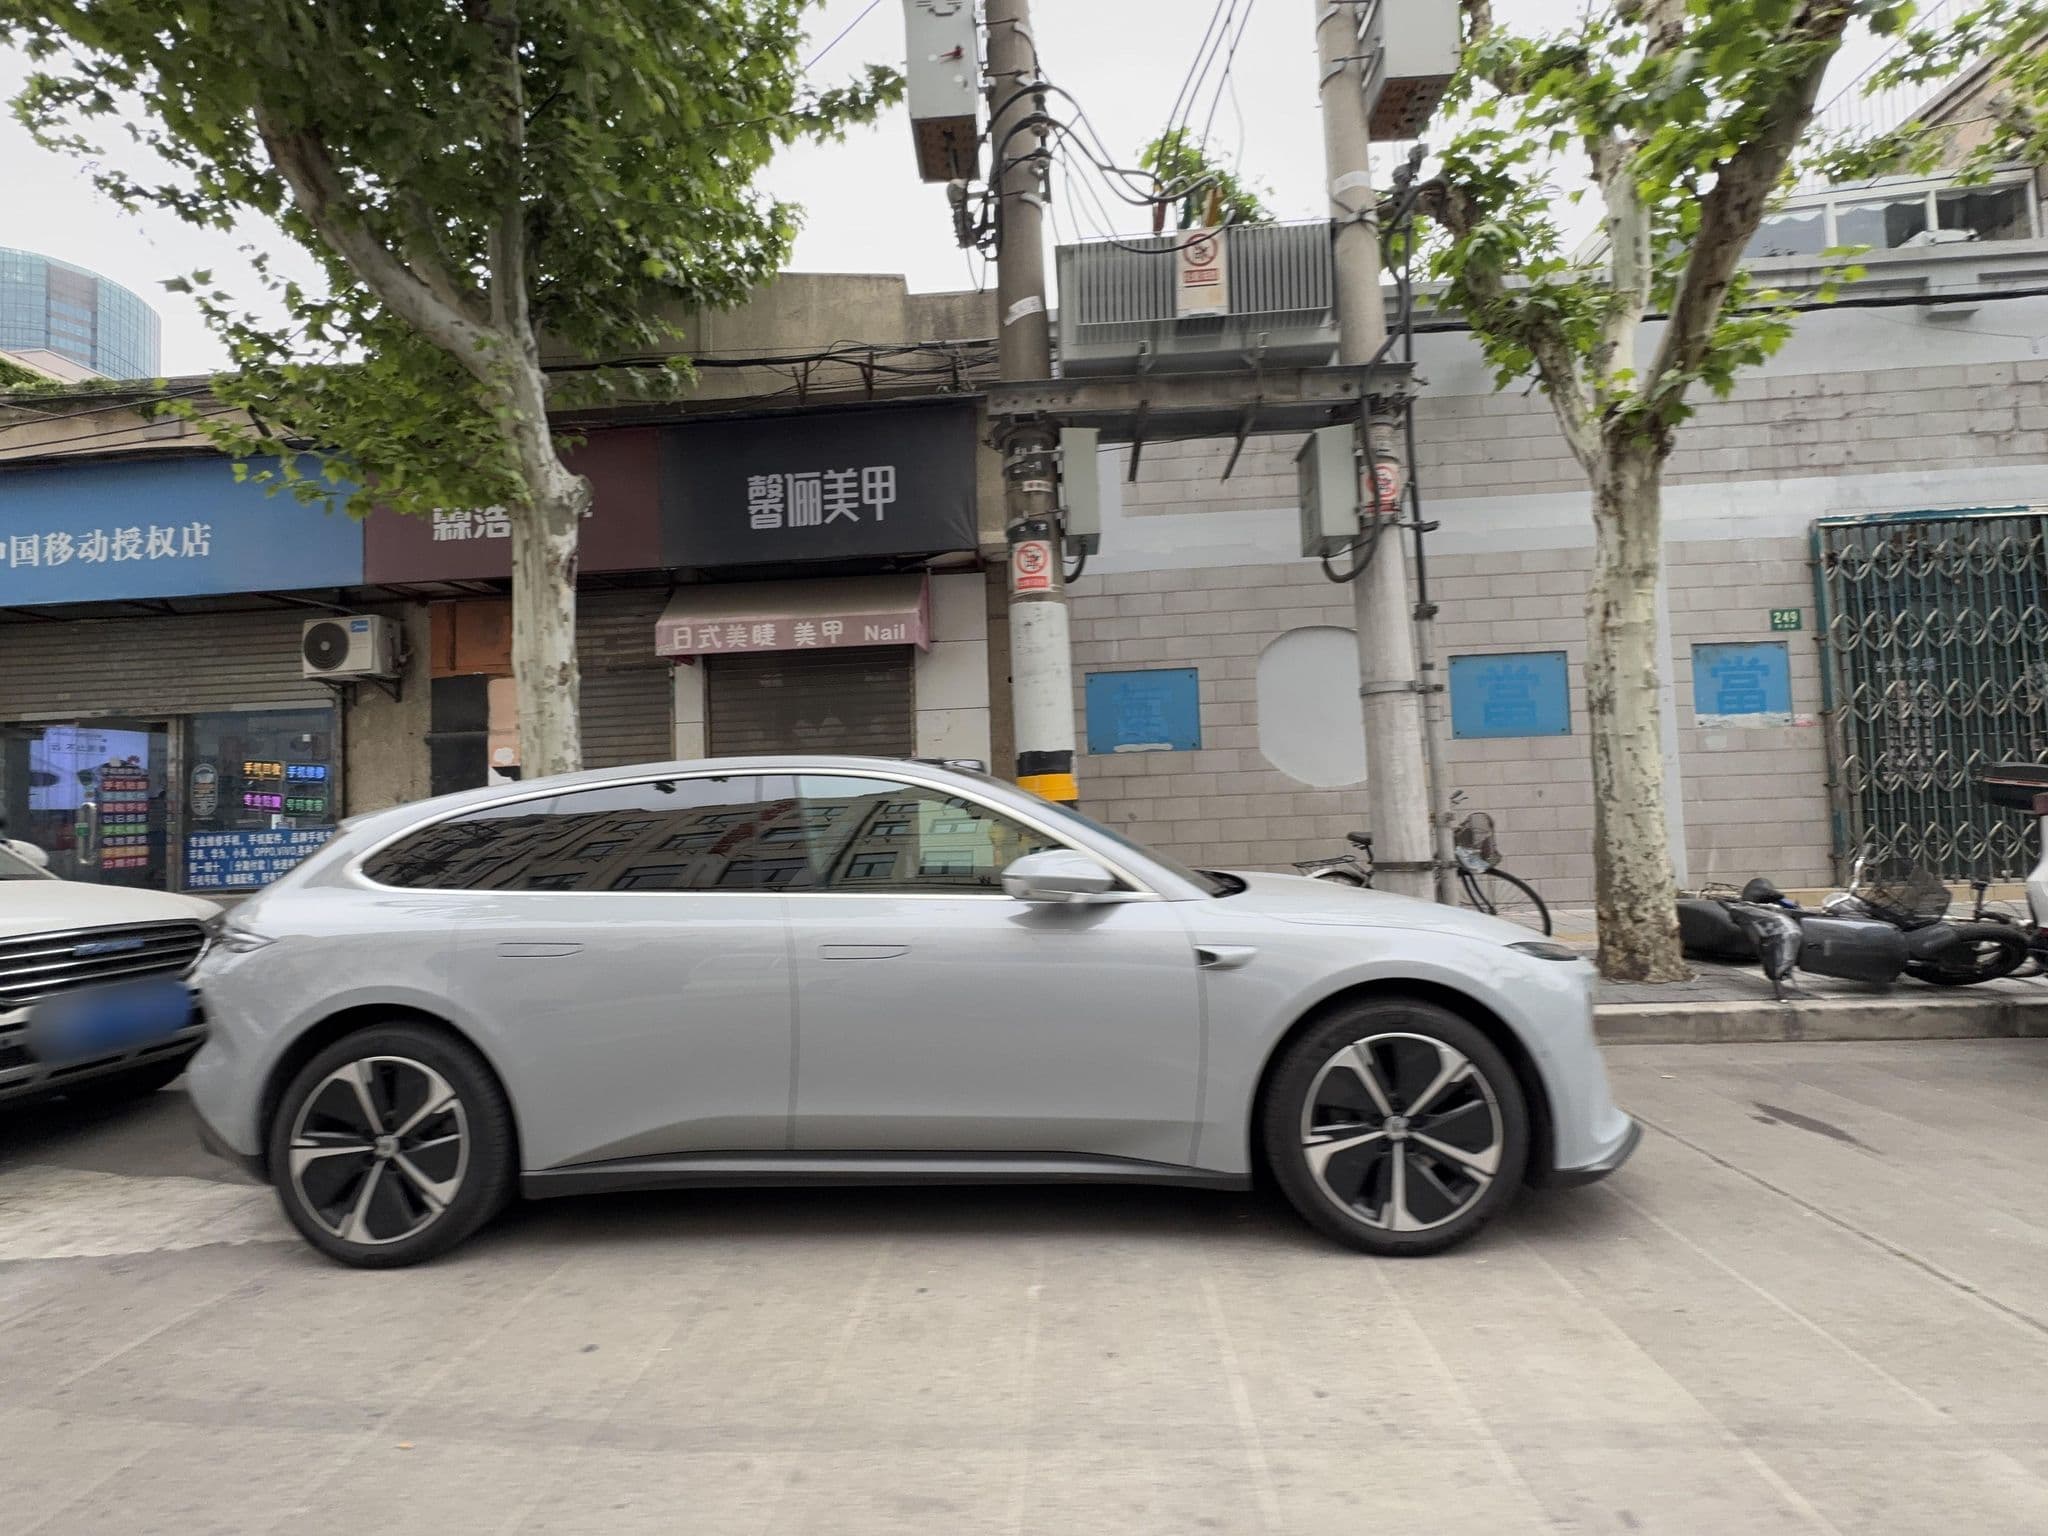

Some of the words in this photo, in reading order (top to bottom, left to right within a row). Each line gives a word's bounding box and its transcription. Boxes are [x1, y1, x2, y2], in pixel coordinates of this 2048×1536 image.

[747, 465, 897, 530] 馨俪美甲
[0, 521, 211, 569] 国移动授权店
[672, 623, 777, 650] 日式美睫
[793, 620, 844, 647] 美甲
[864, 624, 906, 641] Nail
[1772, 611, 1799, 624] 249
